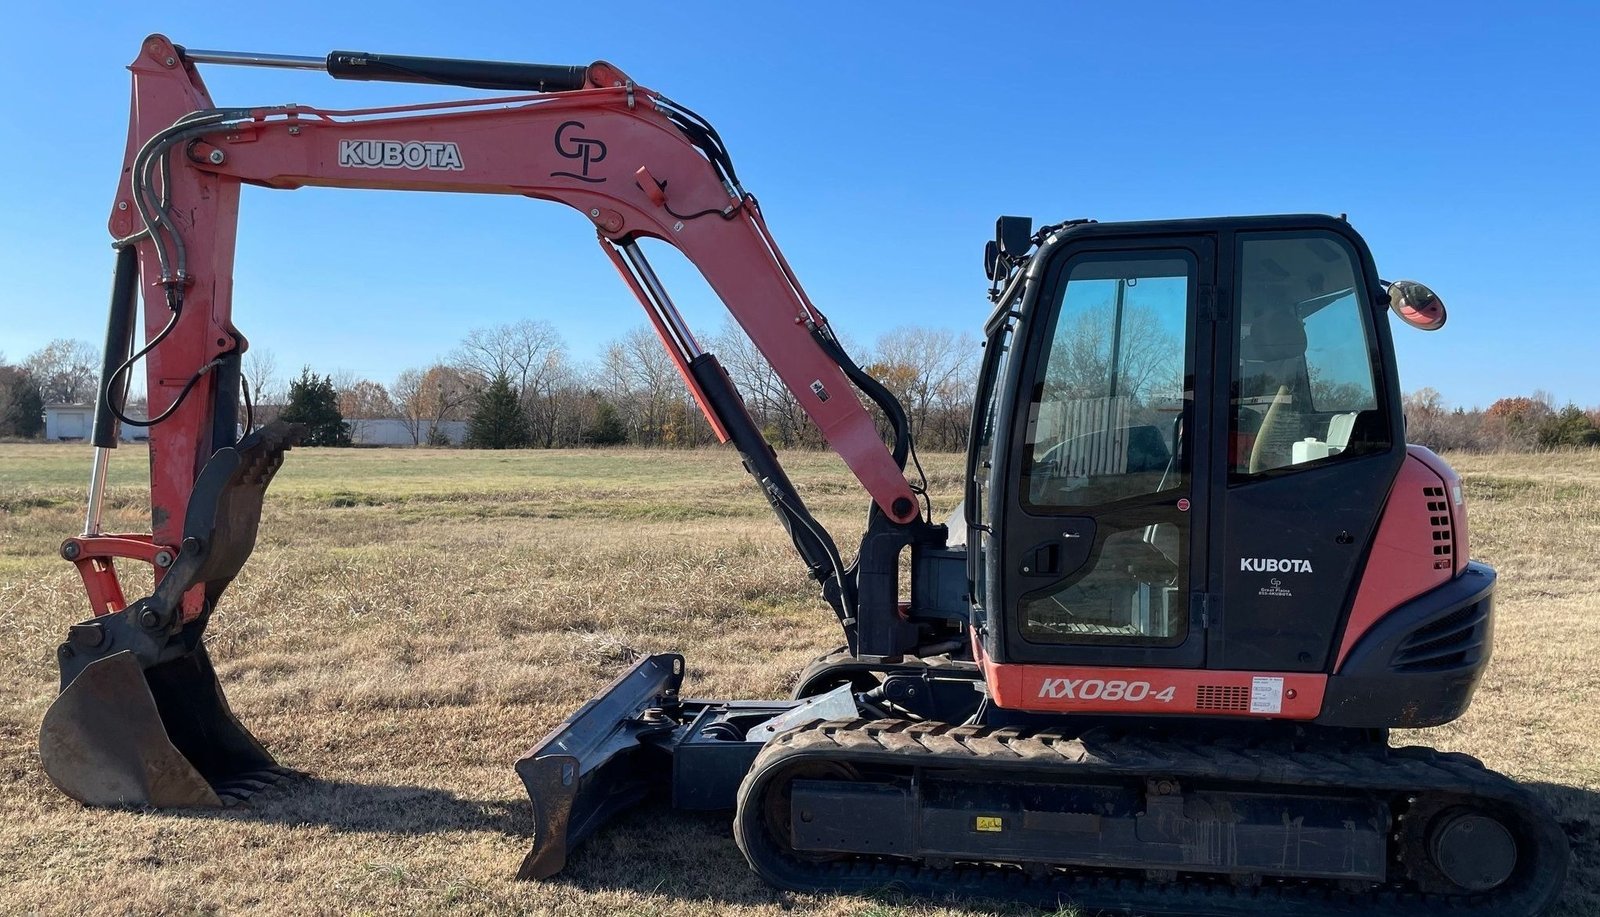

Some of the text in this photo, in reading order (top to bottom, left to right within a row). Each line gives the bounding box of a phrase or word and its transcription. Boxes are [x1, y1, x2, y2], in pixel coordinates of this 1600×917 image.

[339, 140, 464, 169] KUBOTA
[554, 120, 607, 176] GP
[1240, 558, 1313, 573] KUBOTA
[1038, 678, 1176, 702] KX080-4
